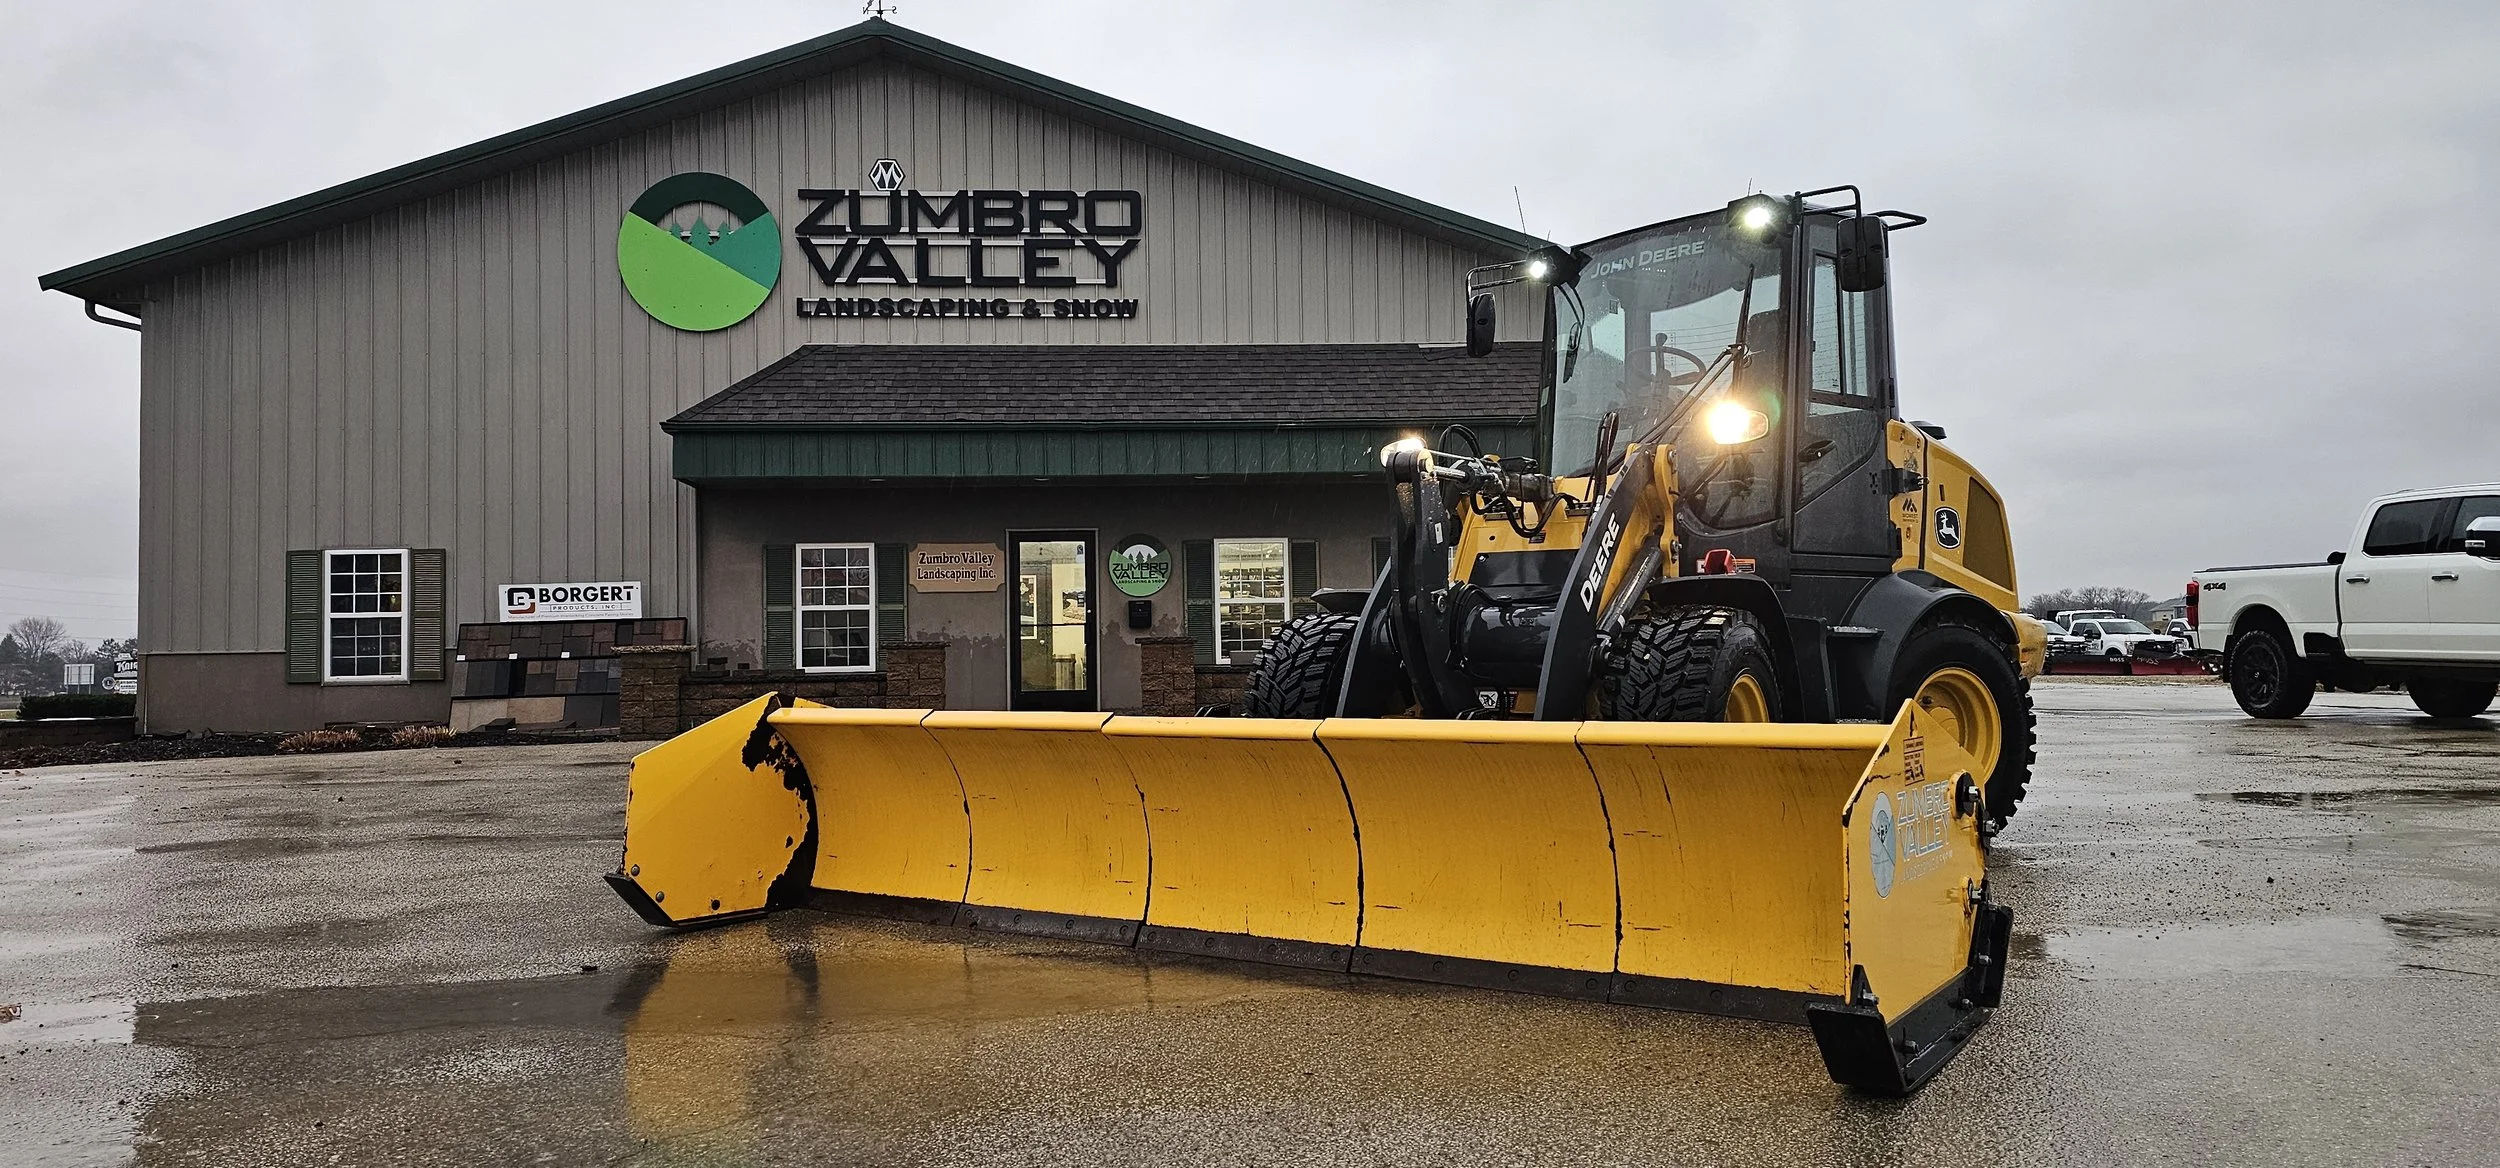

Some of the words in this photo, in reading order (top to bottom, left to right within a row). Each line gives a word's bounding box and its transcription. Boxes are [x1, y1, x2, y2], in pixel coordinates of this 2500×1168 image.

[795, 188, 1142, 236] ZUMBRO
[795, 237, 1142, 288] VALLEY
[1590, 256, 1635, 279] JOHN
[1639, 241, 1705, 267] DEERE
[796, 298, 1009, 319] LANDSCAPING
[1022, 298, 1042, 319] &
[1053, 298, 1139, 319] SNOW
[919, 552, 960, 564] Zumbro
[961, 552, 994, 566] Valley
[1112, 563, 1169, 571] ZUMBRO
[1580, 512, 1620, 613] DEERE
[917, 567, 976, 582] Landscaping
[979, 566, 997, 579] Inc.
[1112, 570, 1168, 580] VALLEY
[539, 587, 633, 603] BORGERT
[1898, 811, 1952, 862] VALLEY
